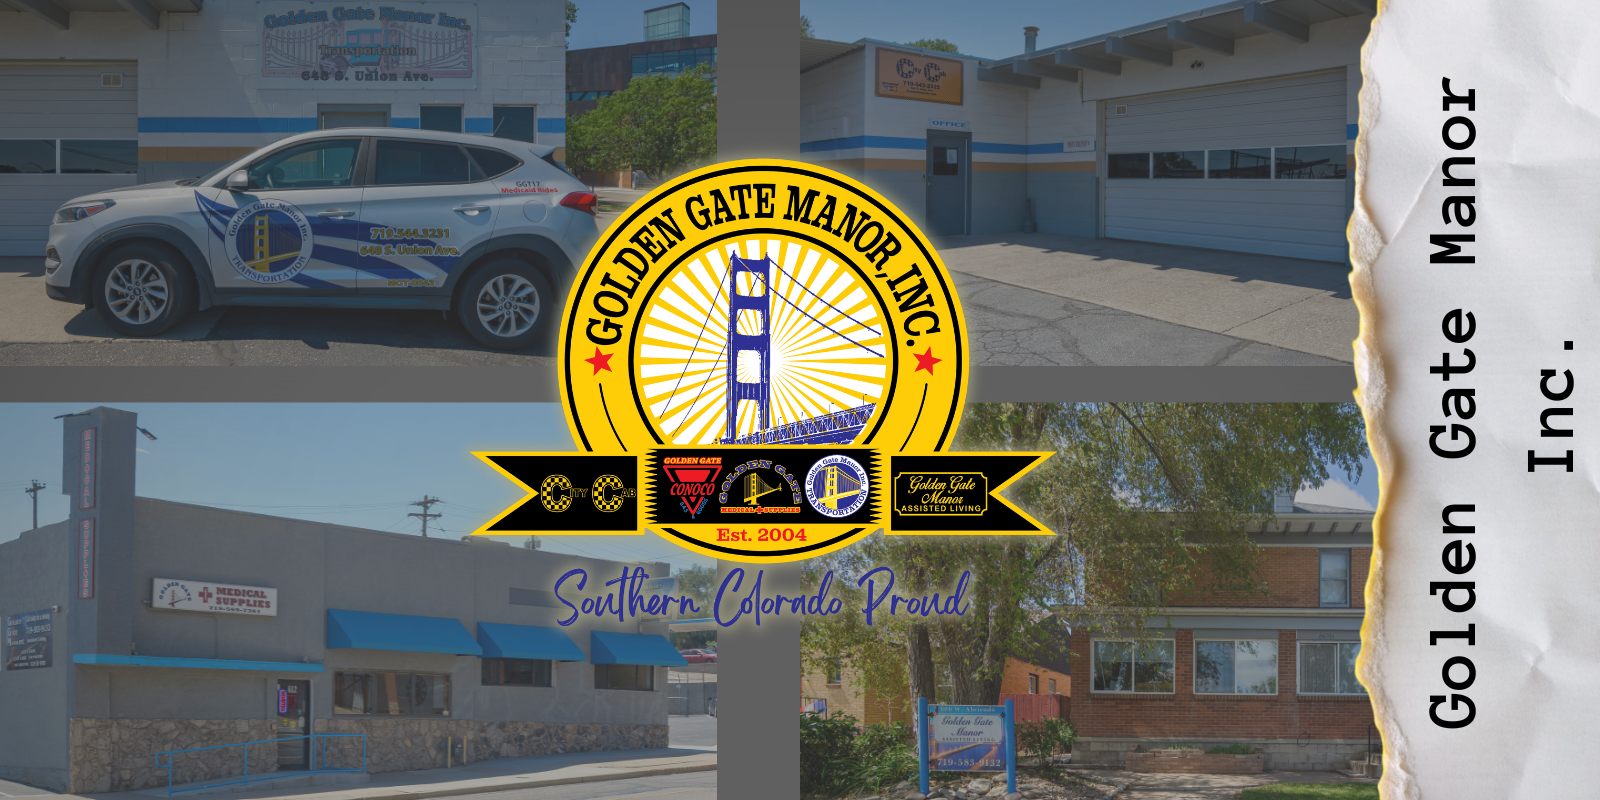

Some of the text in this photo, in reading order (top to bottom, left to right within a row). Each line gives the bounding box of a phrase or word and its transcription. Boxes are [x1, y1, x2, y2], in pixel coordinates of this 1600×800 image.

[264, 6, 471, 30] Golden Gate Manor Inc.
[318, 44, 417, 57] Transportation
[301, 70, 434, 81] 648 S. Union Ave.
[931, 120, 967, 128] OFFICE
[228, 202, 309, 242] Golden Gate Manor Inc.
[370, 228, 450, 239] 719.544.3231
[360, 245, 460, 255] 648 S. Union Ave.
[231, 255, 307, 282] TRANSPORTATION
[387, 279, 435, 287] MCT-0042
[159, 581, 192, 601] GOLDEN GATE
[216, 586, 267, 599] MEDICAL
[216, 597, 271, 609] SUPPLIES
[941, 715, 994, 726] Golden Gate
[950, 726, 984, 736] Manor
[937, 758, 1001, 767] 719-583-9132
